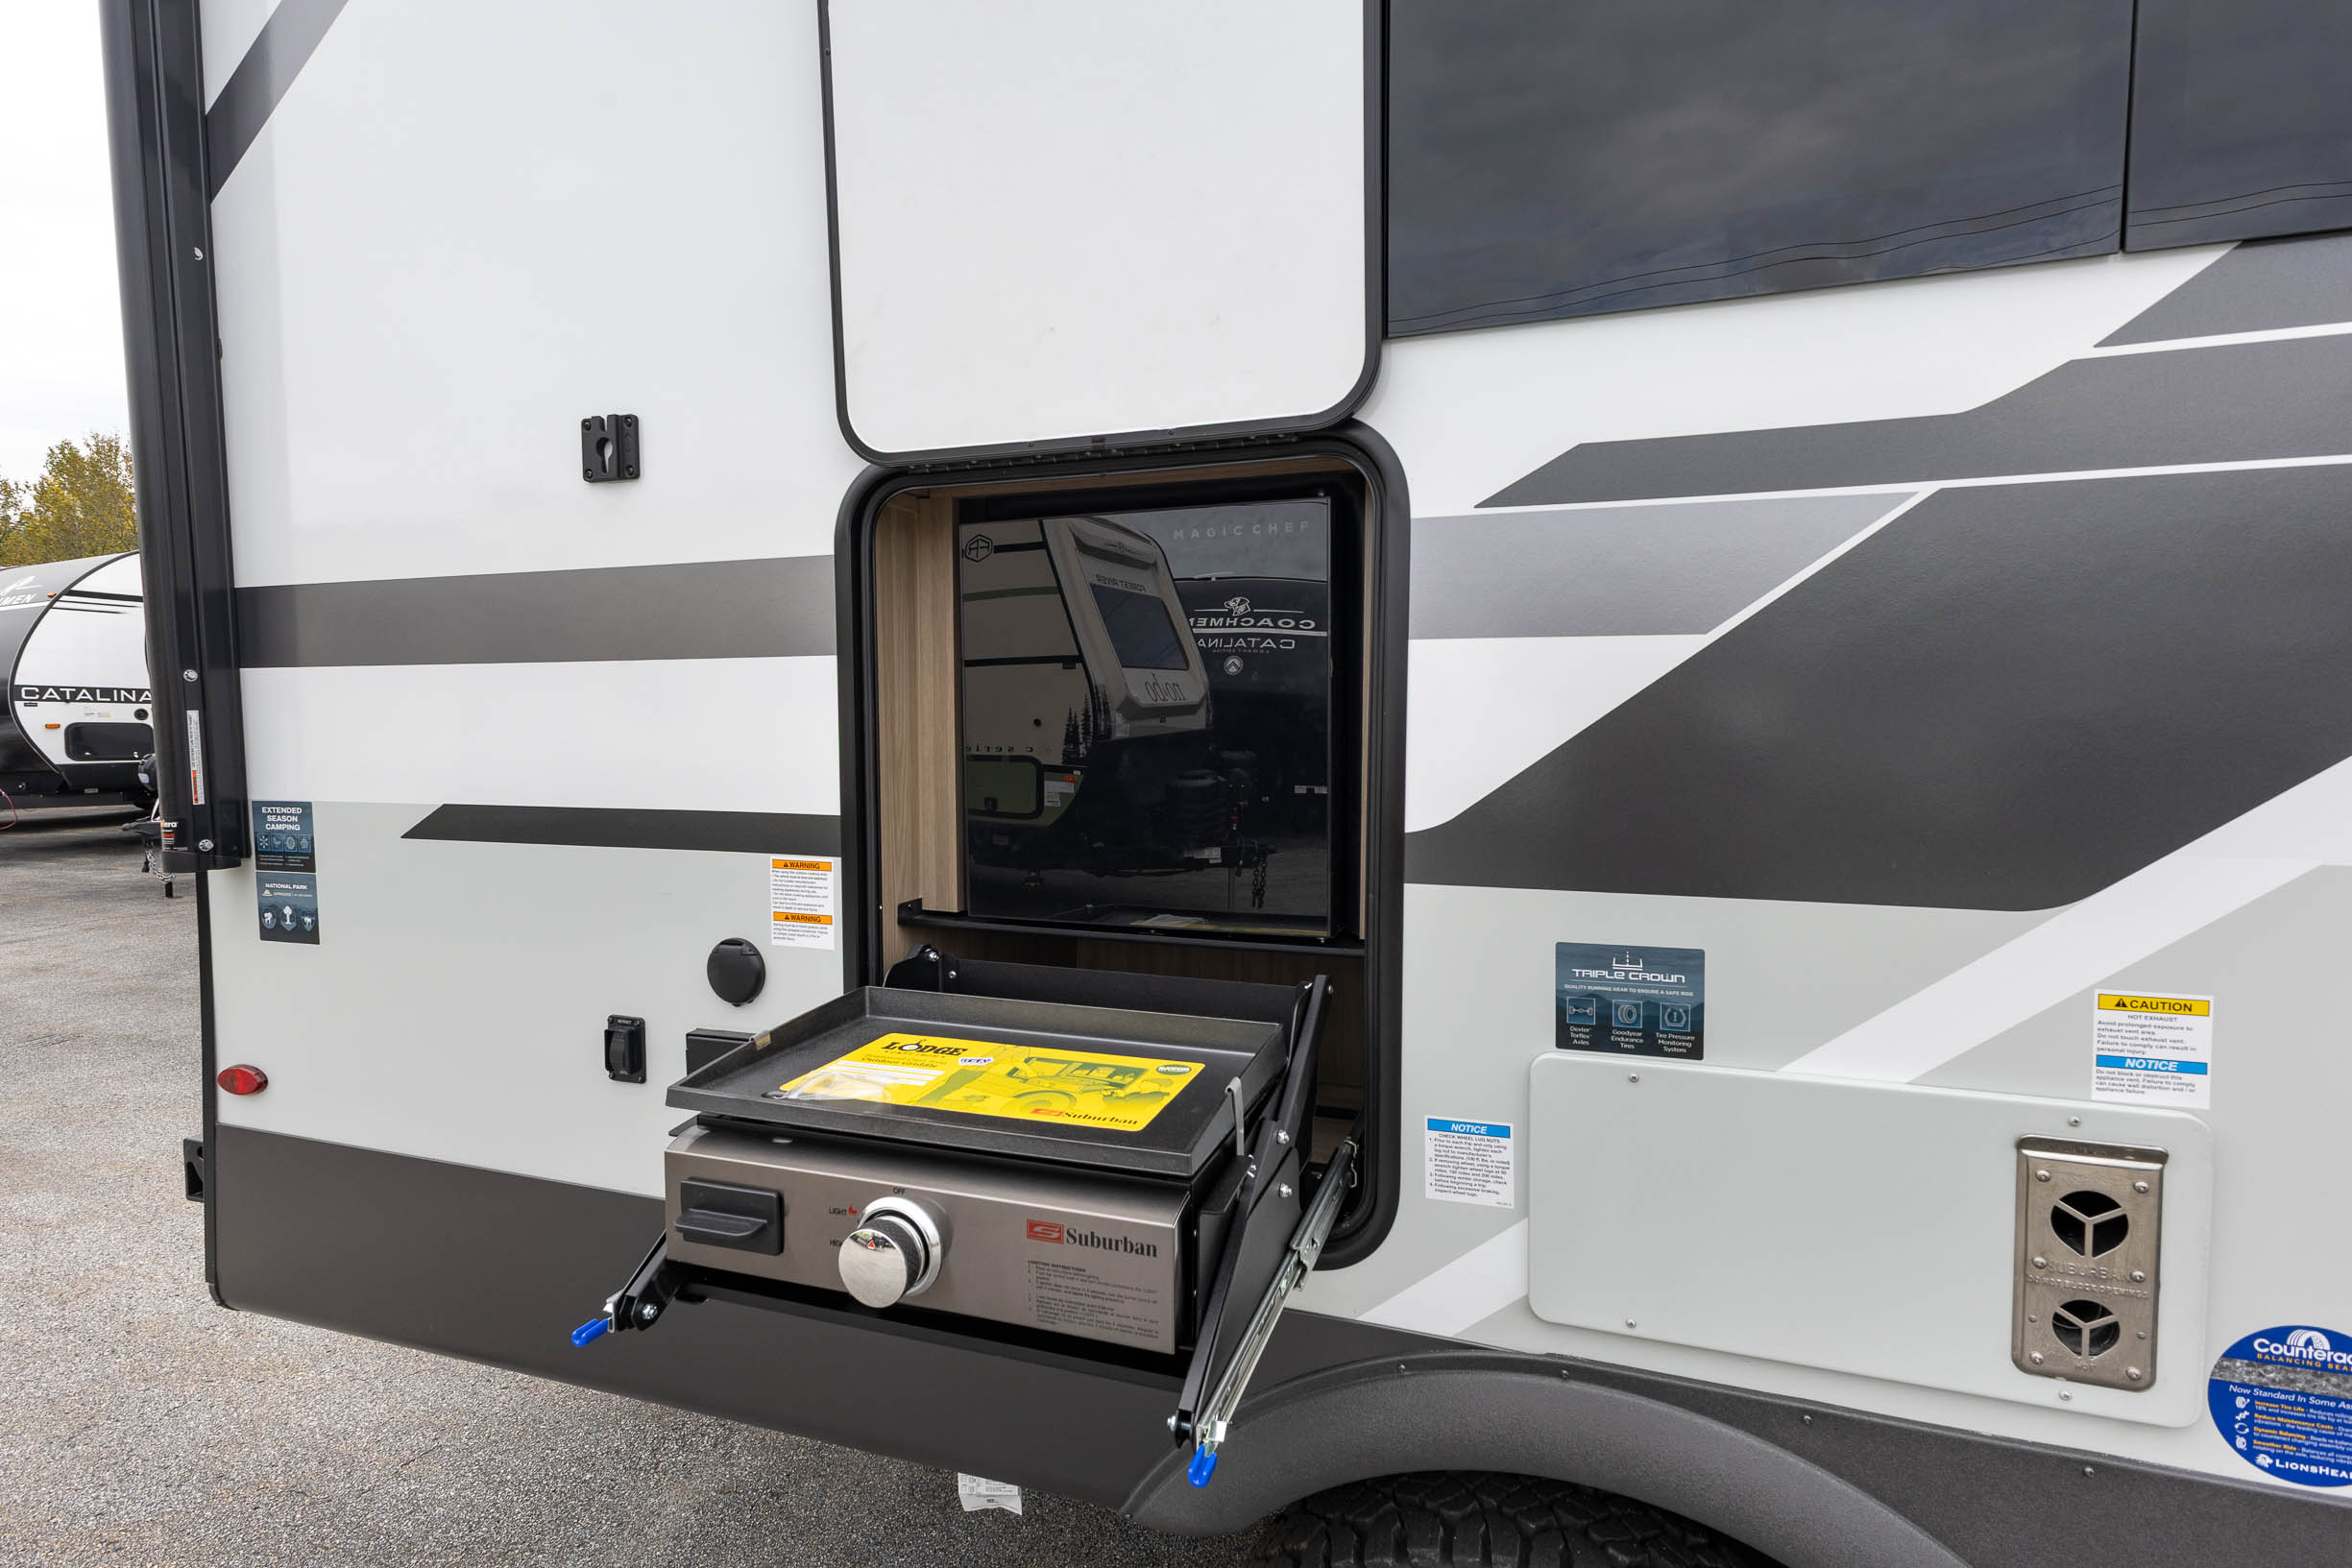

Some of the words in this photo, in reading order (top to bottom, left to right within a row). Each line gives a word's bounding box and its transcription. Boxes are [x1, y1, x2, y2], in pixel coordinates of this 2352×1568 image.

[1174, 525, 1243, 540] MAGIC
[1252, 521, 1310, 535] CHEF
[21, 687, 152, 702] CATALINA
[1571, 968, 1625, 980] TRIPLE
[1628, 972, 1685, 984] CROWN
[2129, 1000, 2193, 1012] CAUTION
[882, 1040, 968, 1056] LODGE
[2124, 1058, 2179, 1072] NOTICE
[1451, 1123, 1488, 1134] NOTICE
[829, 1207, 847, 1217] LIGHT
[1066, 1227, 1157, 1258] Suburban
[2257, 1353, 2321, 1367] BALANCING
[2229, 1385, 2251, 1394] Now
[2253, 1387, 2295, 1402] Standard
[2309, 1396, 2337, 1408] Some
[2277, 1416, 2315, 1428] Maintenance
[2253, 1426, 2278, 1435] Dynamic
[2279, 1430, 2306, 1440] Balancing
[2253, 1439, 2282, 1467] Smoother
[2260, 1433, 2291, 1460] counteract
[2291, 1437, 2317, 1466] changing
[2310, 1455, 2334, 1463] reducing
